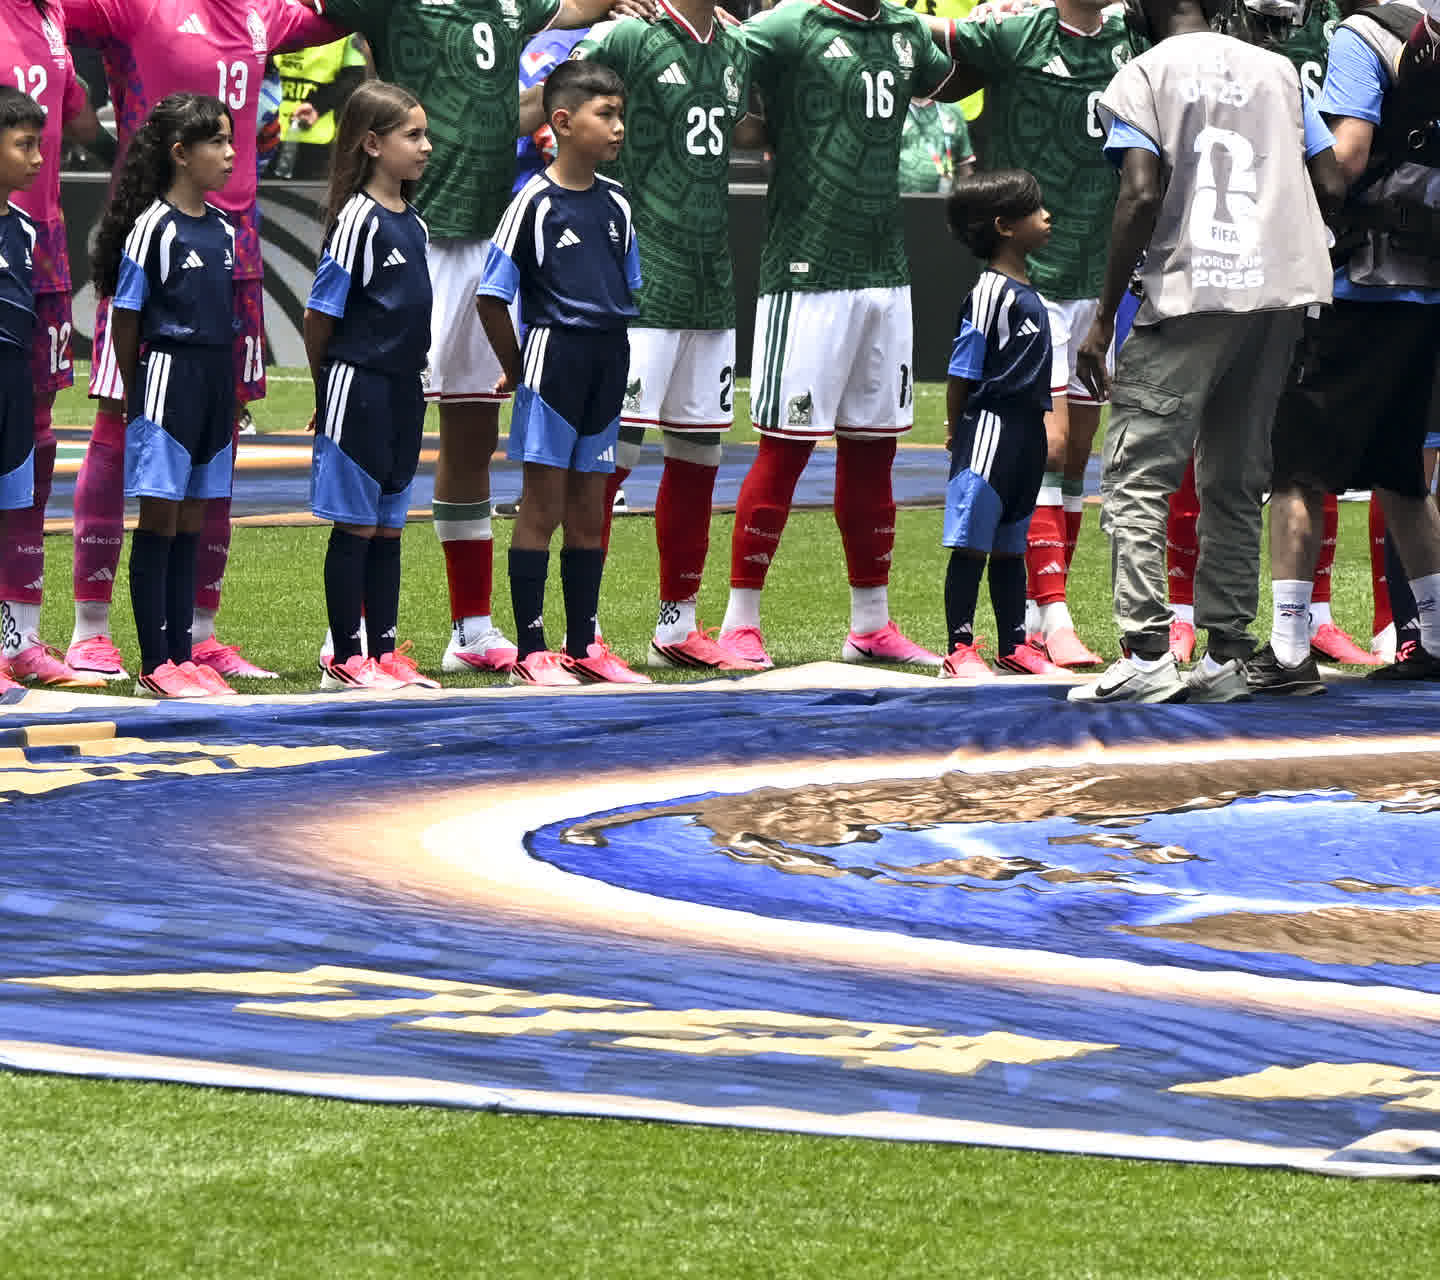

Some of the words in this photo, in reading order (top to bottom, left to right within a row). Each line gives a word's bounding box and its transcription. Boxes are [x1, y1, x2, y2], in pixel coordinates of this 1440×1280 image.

[472, 21, 496, 71] 9
[12, 64, 49, 116] 12
[216, 60, 249, 111] 13
[861, 70, 895, 119] 16
[686, 105, 725, 157] 25
[1210, 225, 1241, 242] FIFA
[1191, 254, 1234, 271] WORLD
[47, 321, 72, 375] 12
